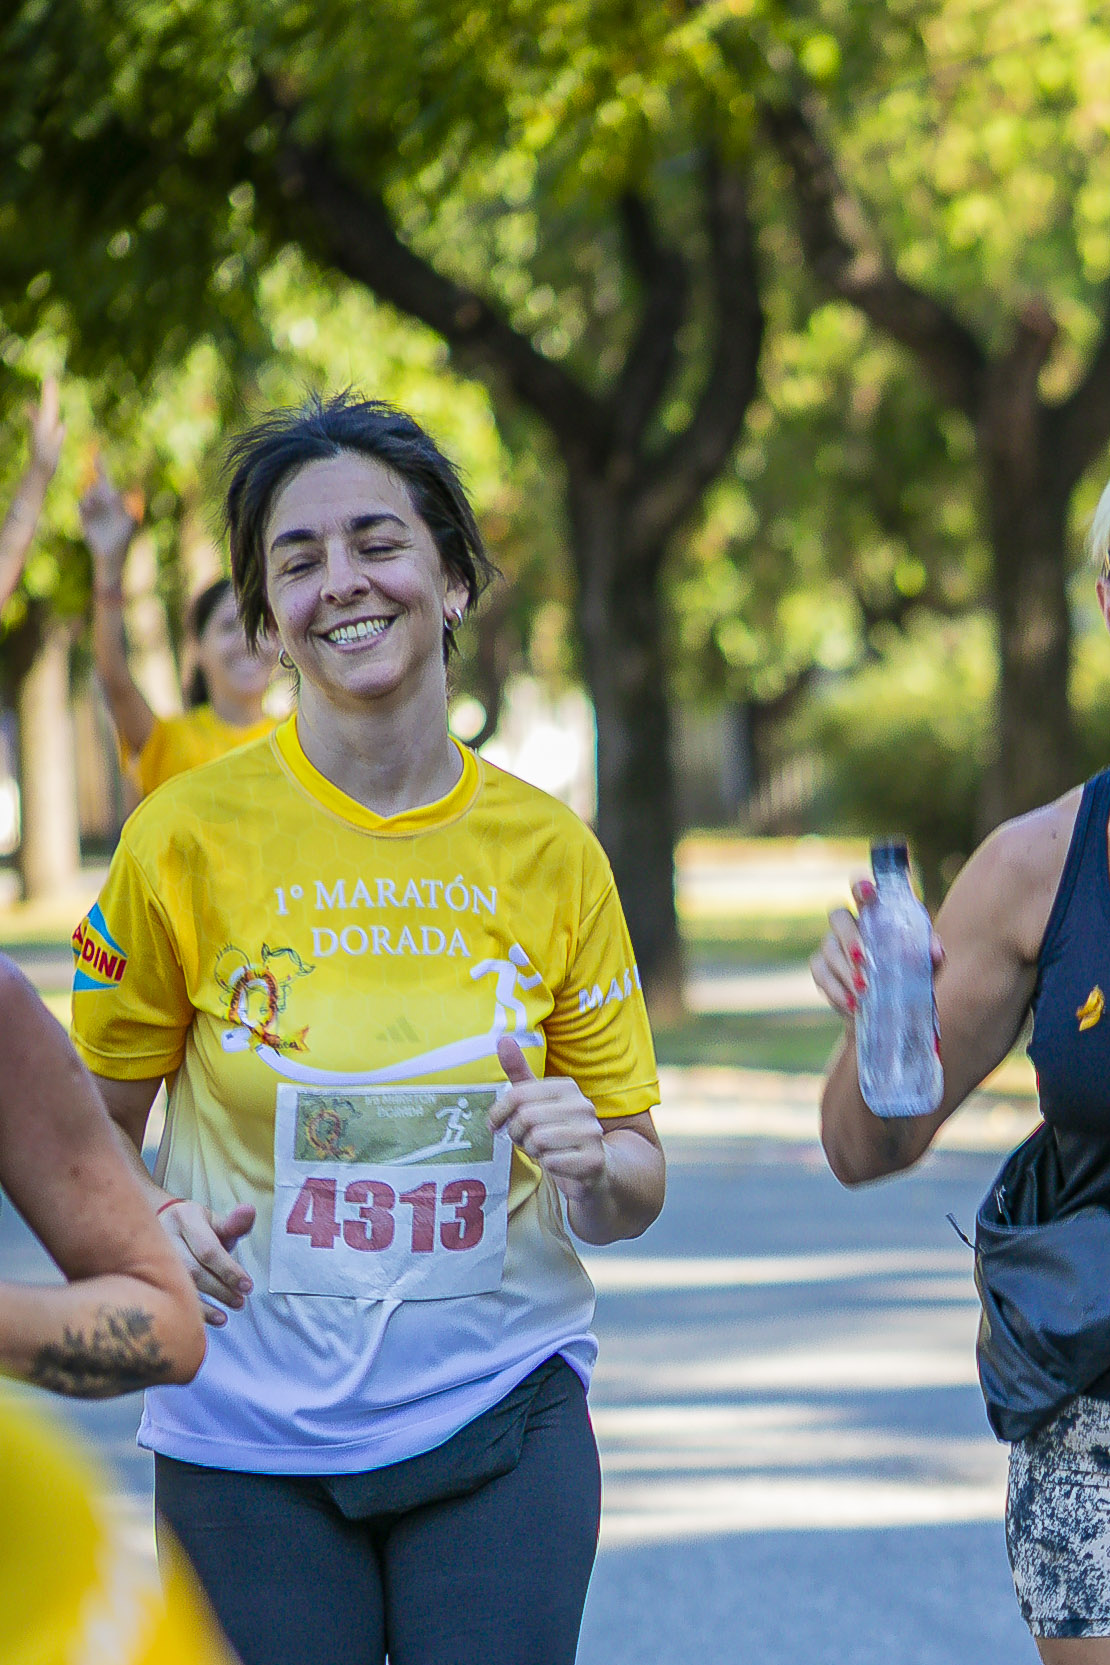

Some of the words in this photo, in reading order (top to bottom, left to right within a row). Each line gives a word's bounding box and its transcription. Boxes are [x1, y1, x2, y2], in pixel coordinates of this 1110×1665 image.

[315, 875, 498, 914] MARATÓN
[311, 926, 471, 957] DORADA
[286, 1178, 488, 1254] 4313
